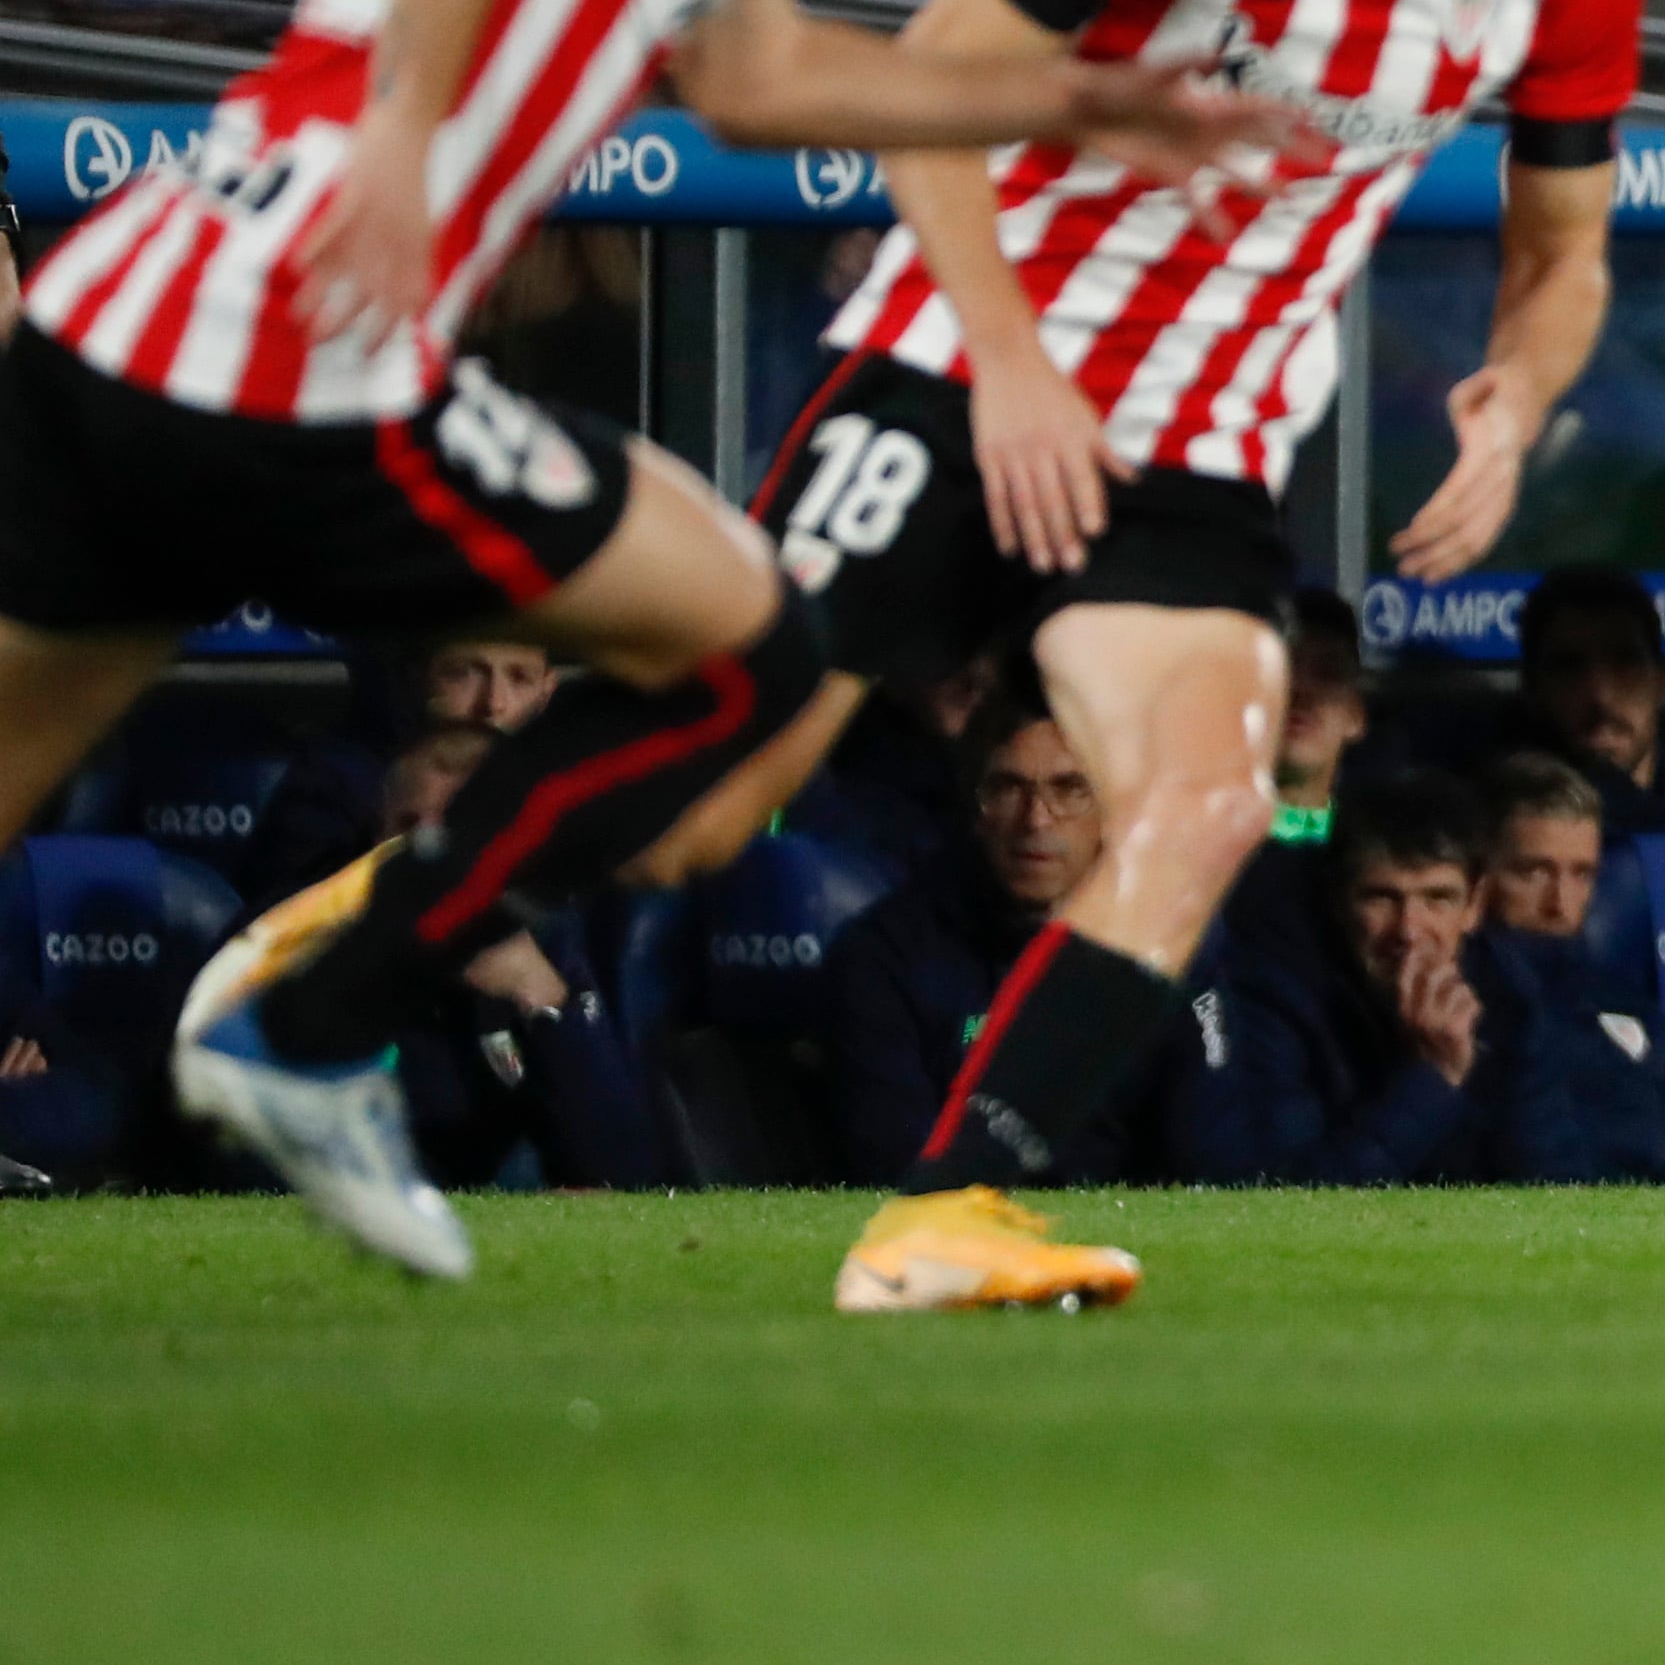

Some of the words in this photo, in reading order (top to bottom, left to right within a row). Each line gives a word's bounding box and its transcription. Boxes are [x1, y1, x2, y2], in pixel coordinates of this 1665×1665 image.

[566, 134, 679, 197] MPO
[786, 412, 935, 557] 18
[44, 932, 158, 963] CAZOO
